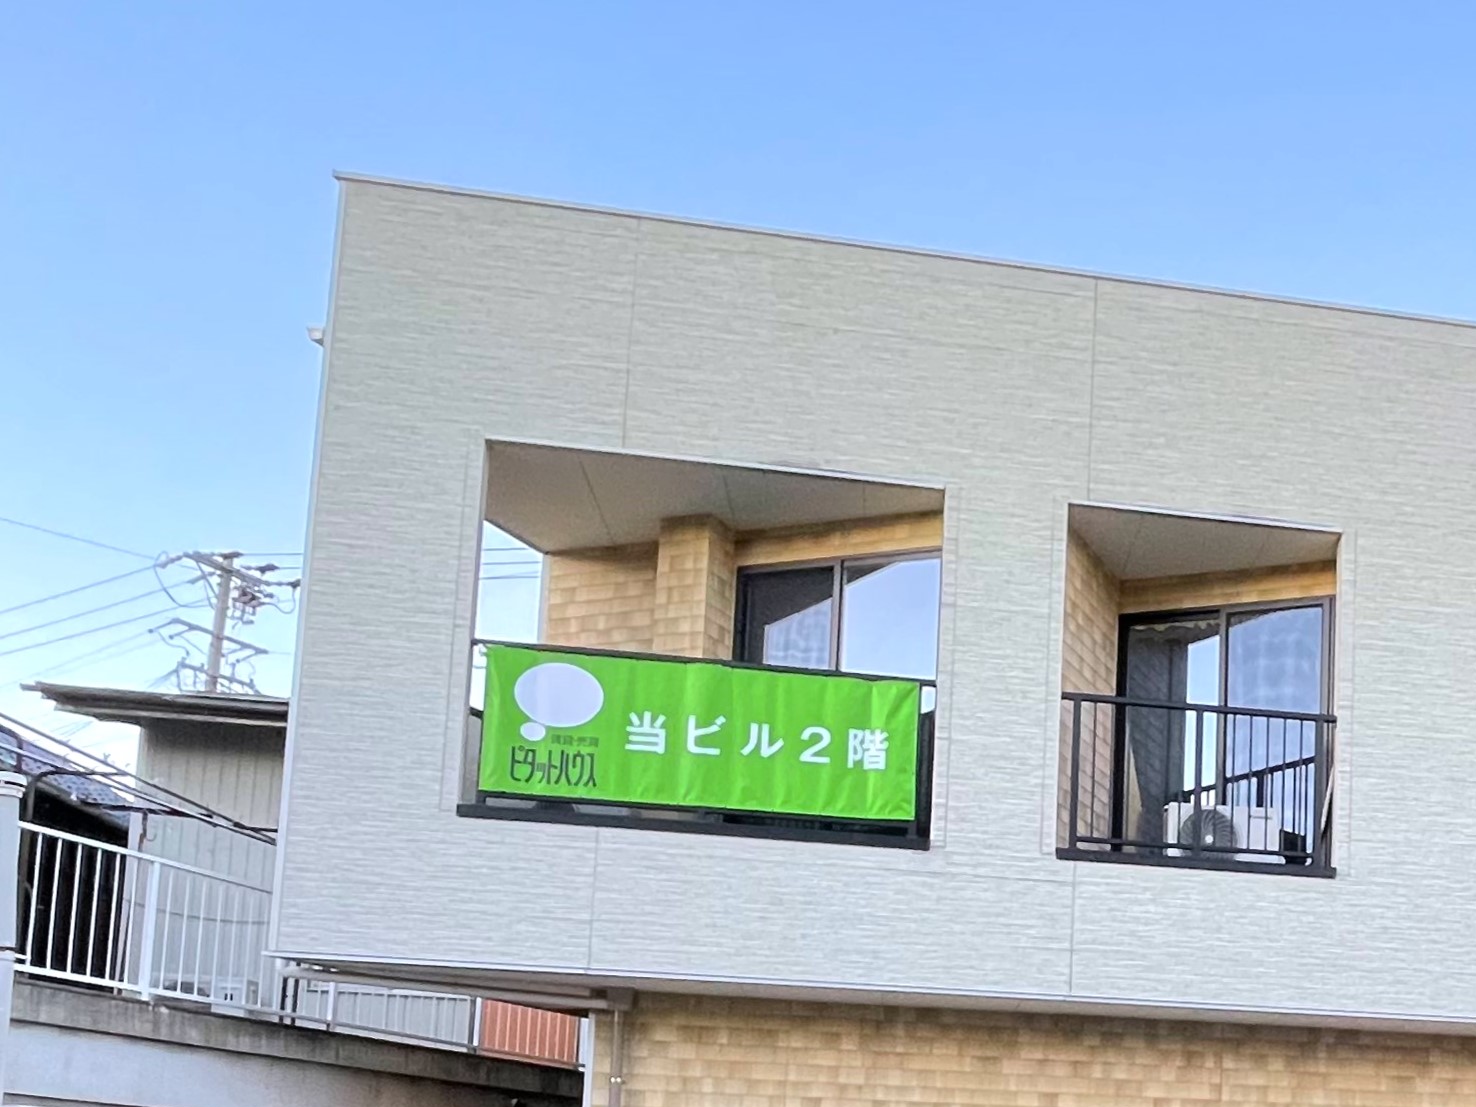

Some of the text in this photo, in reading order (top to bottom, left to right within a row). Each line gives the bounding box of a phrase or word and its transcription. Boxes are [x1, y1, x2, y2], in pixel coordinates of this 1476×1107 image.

[510, 744, 598, 788] ピタットハウス
[624, 710, 890, 771] 当ビル2階
